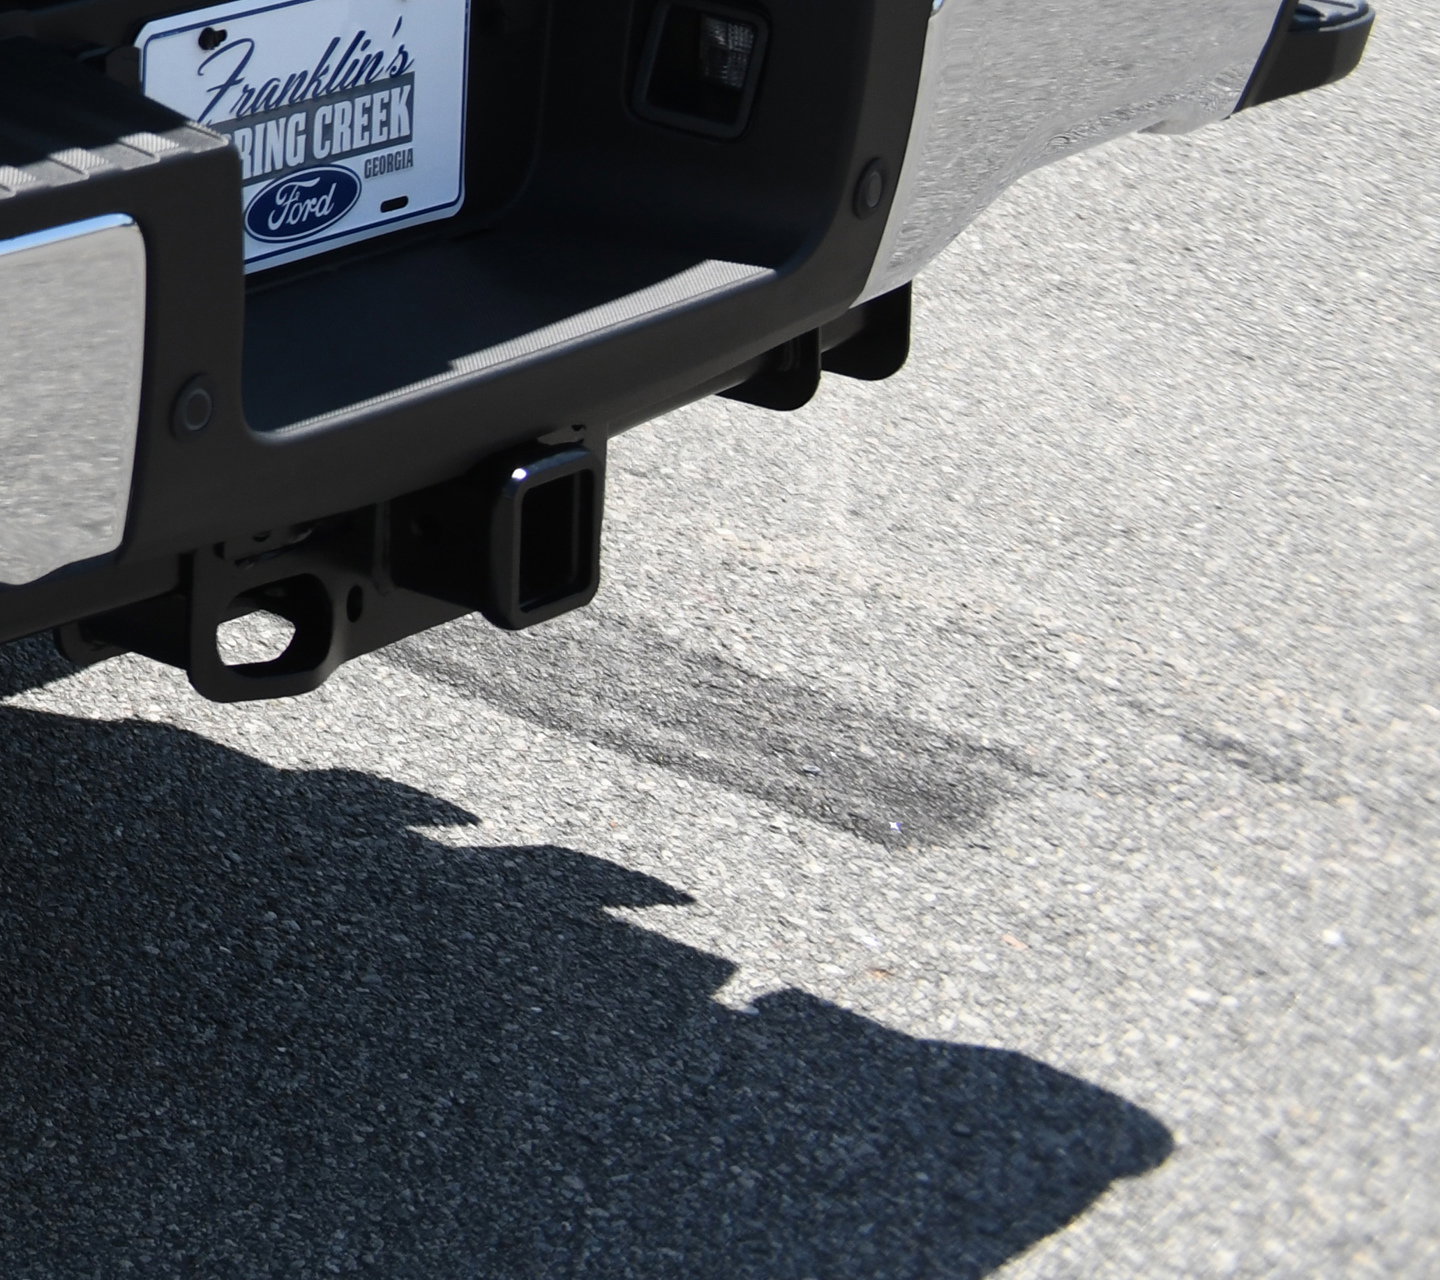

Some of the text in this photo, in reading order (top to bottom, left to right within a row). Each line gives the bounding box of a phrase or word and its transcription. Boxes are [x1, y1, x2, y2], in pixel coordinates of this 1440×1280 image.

[197, 15, 415, 124] Franklin's
[226, 84, 413, 181] RING CREEK
[363, 148, 414, 180] GEORGIA
[267, 176, 337, 231] Ford
